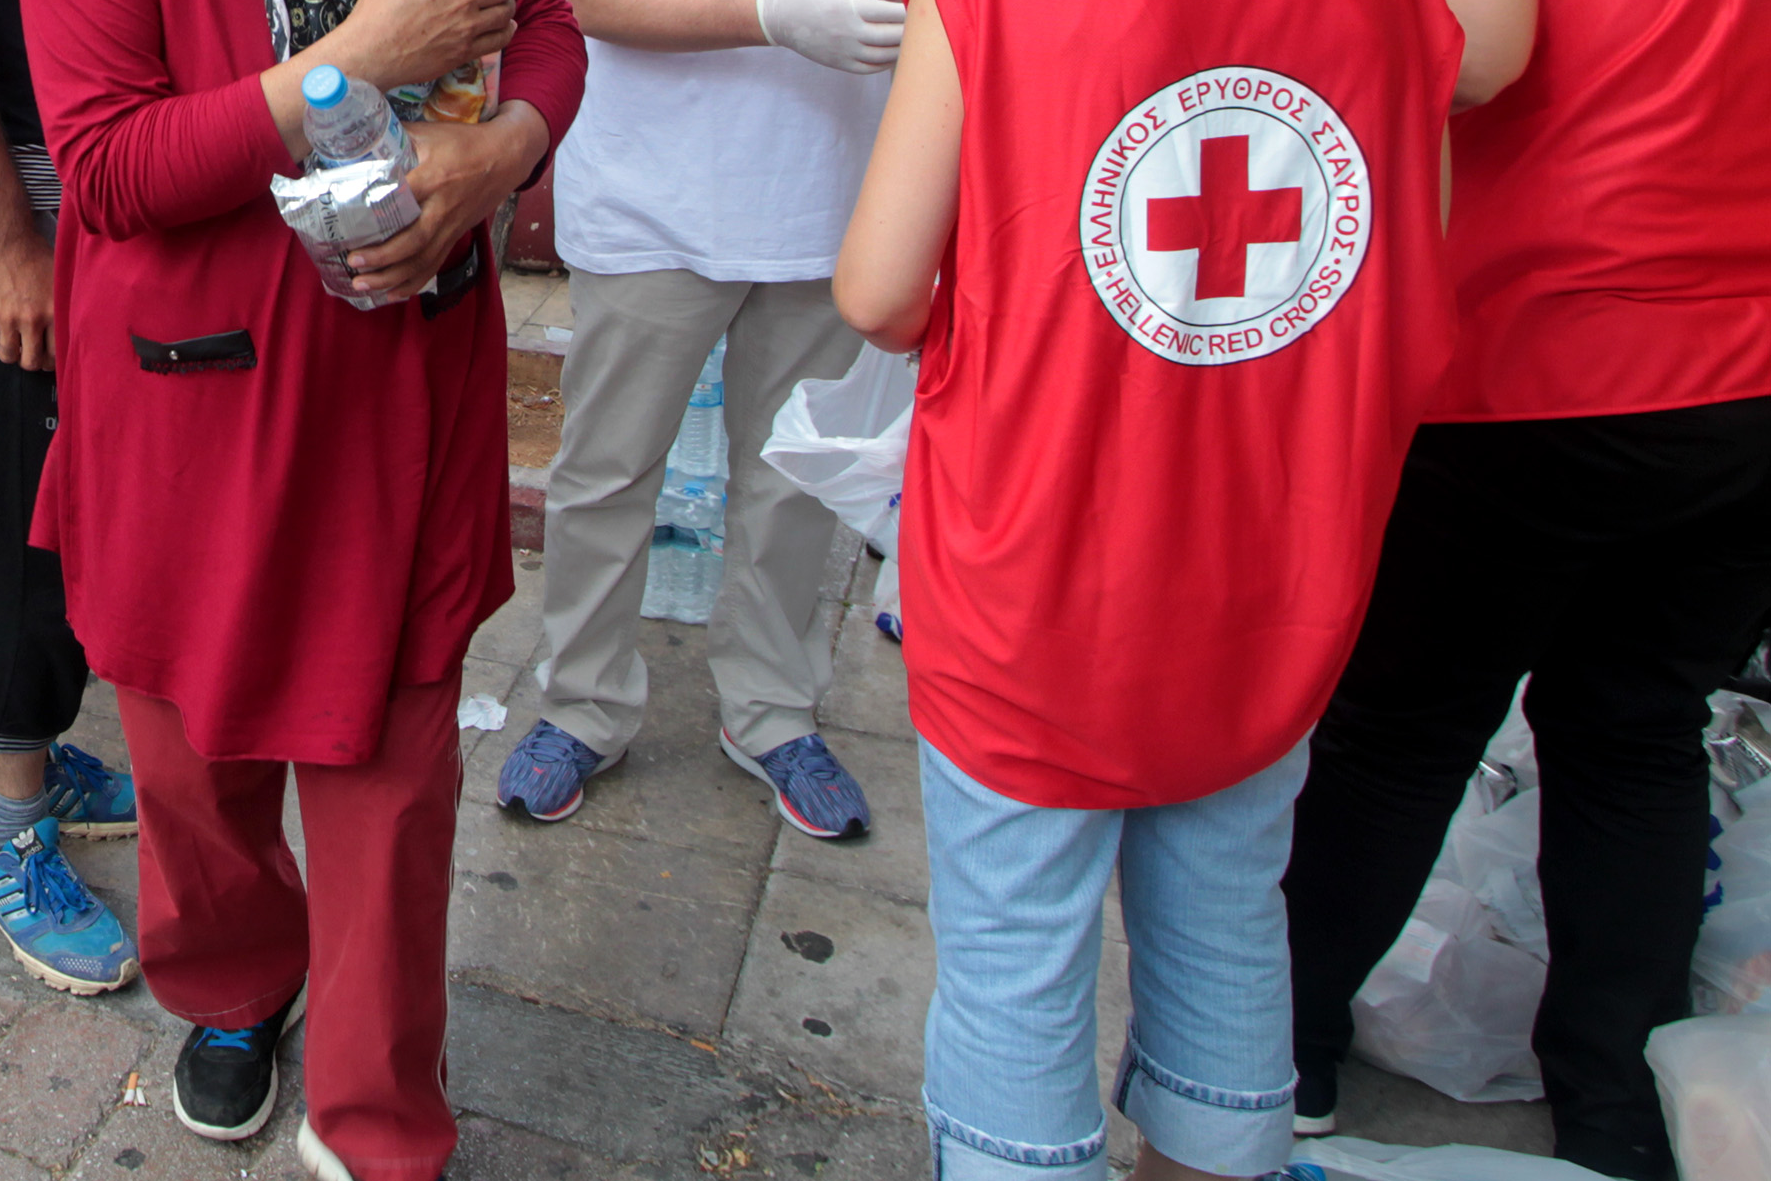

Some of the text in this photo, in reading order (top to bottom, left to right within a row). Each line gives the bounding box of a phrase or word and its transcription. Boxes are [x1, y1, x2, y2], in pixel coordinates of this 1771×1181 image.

[1089, 76, 1361, 270] ΕΛΛΗΝΙΚΟΣ ΕΡΥΘΡΟΣ ΣΤΑΥΡΟΣ
[1105, 265, 1343, 356] HELLENIC RED CROSS
